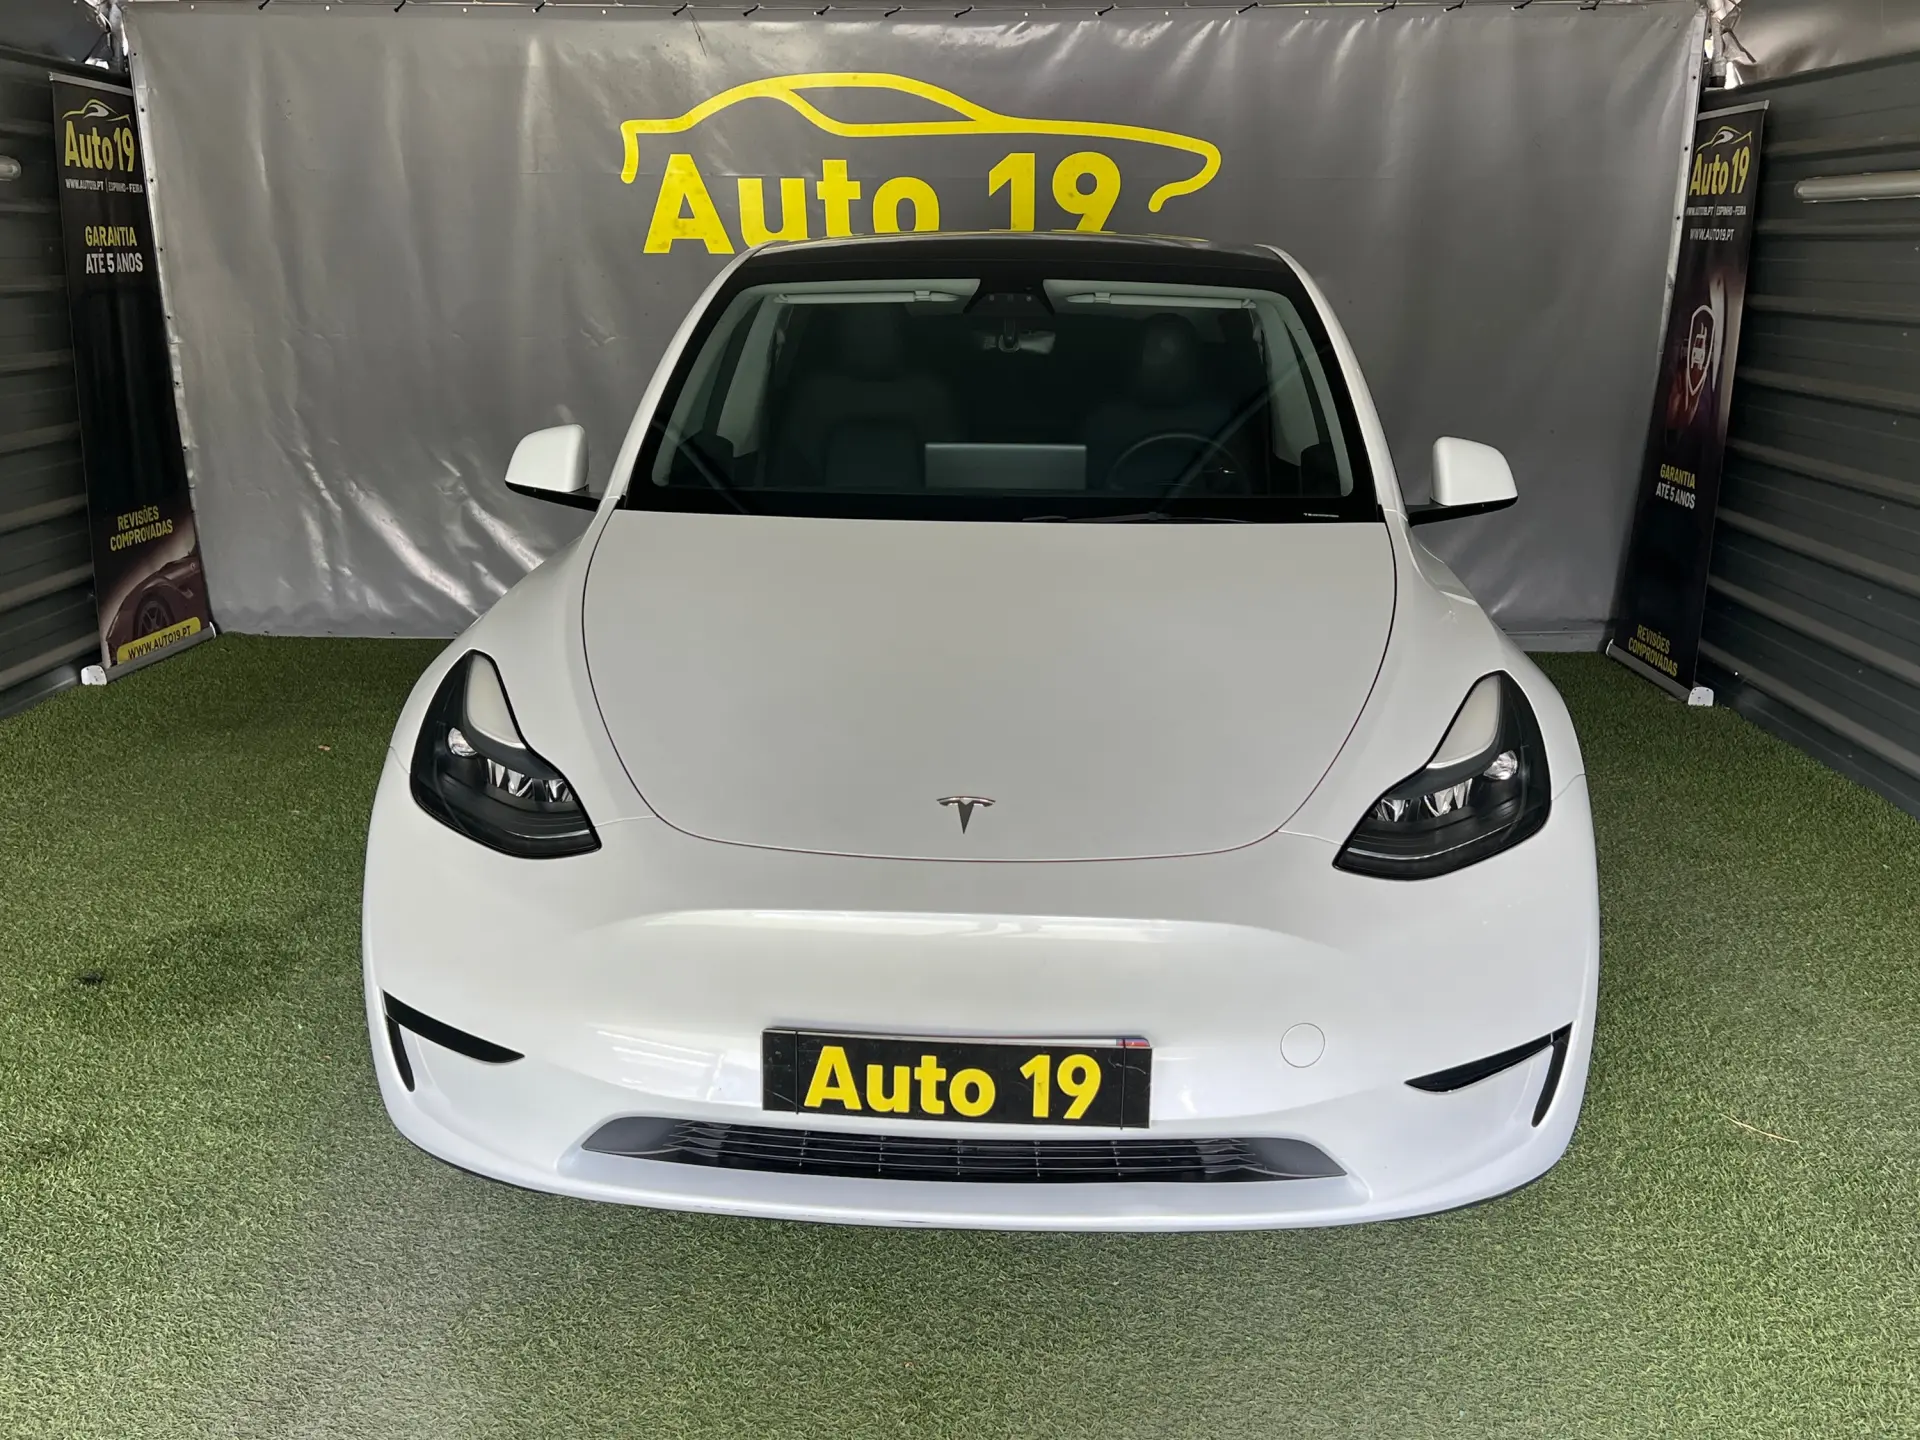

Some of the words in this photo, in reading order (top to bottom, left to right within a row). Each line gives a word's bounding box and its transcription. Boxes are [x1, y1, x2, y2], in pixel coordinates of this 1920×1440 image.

[65, 120, 113, 170] Auto
[114, 127, 135, 172] 19
[1689, 153, 1729, 196] Auto
[1730, 146, 1750, 194] 19
[643, 152, 939, 254] Auto
[988, 151, 1121, 231] 19
[85, 225, 137, 247] GARANTIA
[85, 248, 106, 274] ATÉ
[106, 253, 115, 273] 5
[116, 252, 143, 273] ANOS
[1660, 463, 1696, 489] GARANTIA
[1655, 481, 1670, 500] ATÉ
[1669, 486, 1676, 502] 5
[1674, 488, 1696, 510] ANOS
[110, 518, 173, 551] COMPROVADAS
[117, 505, 160, 531] REVISÕES
[127, 625, 192, 660] WWW.AUTO19.PT
[1628, 637, 1678, 677] COMPROVADAS
[804, 1045, 996, 1117] Auto
[1019, 1053, 1102, 1120] 19
